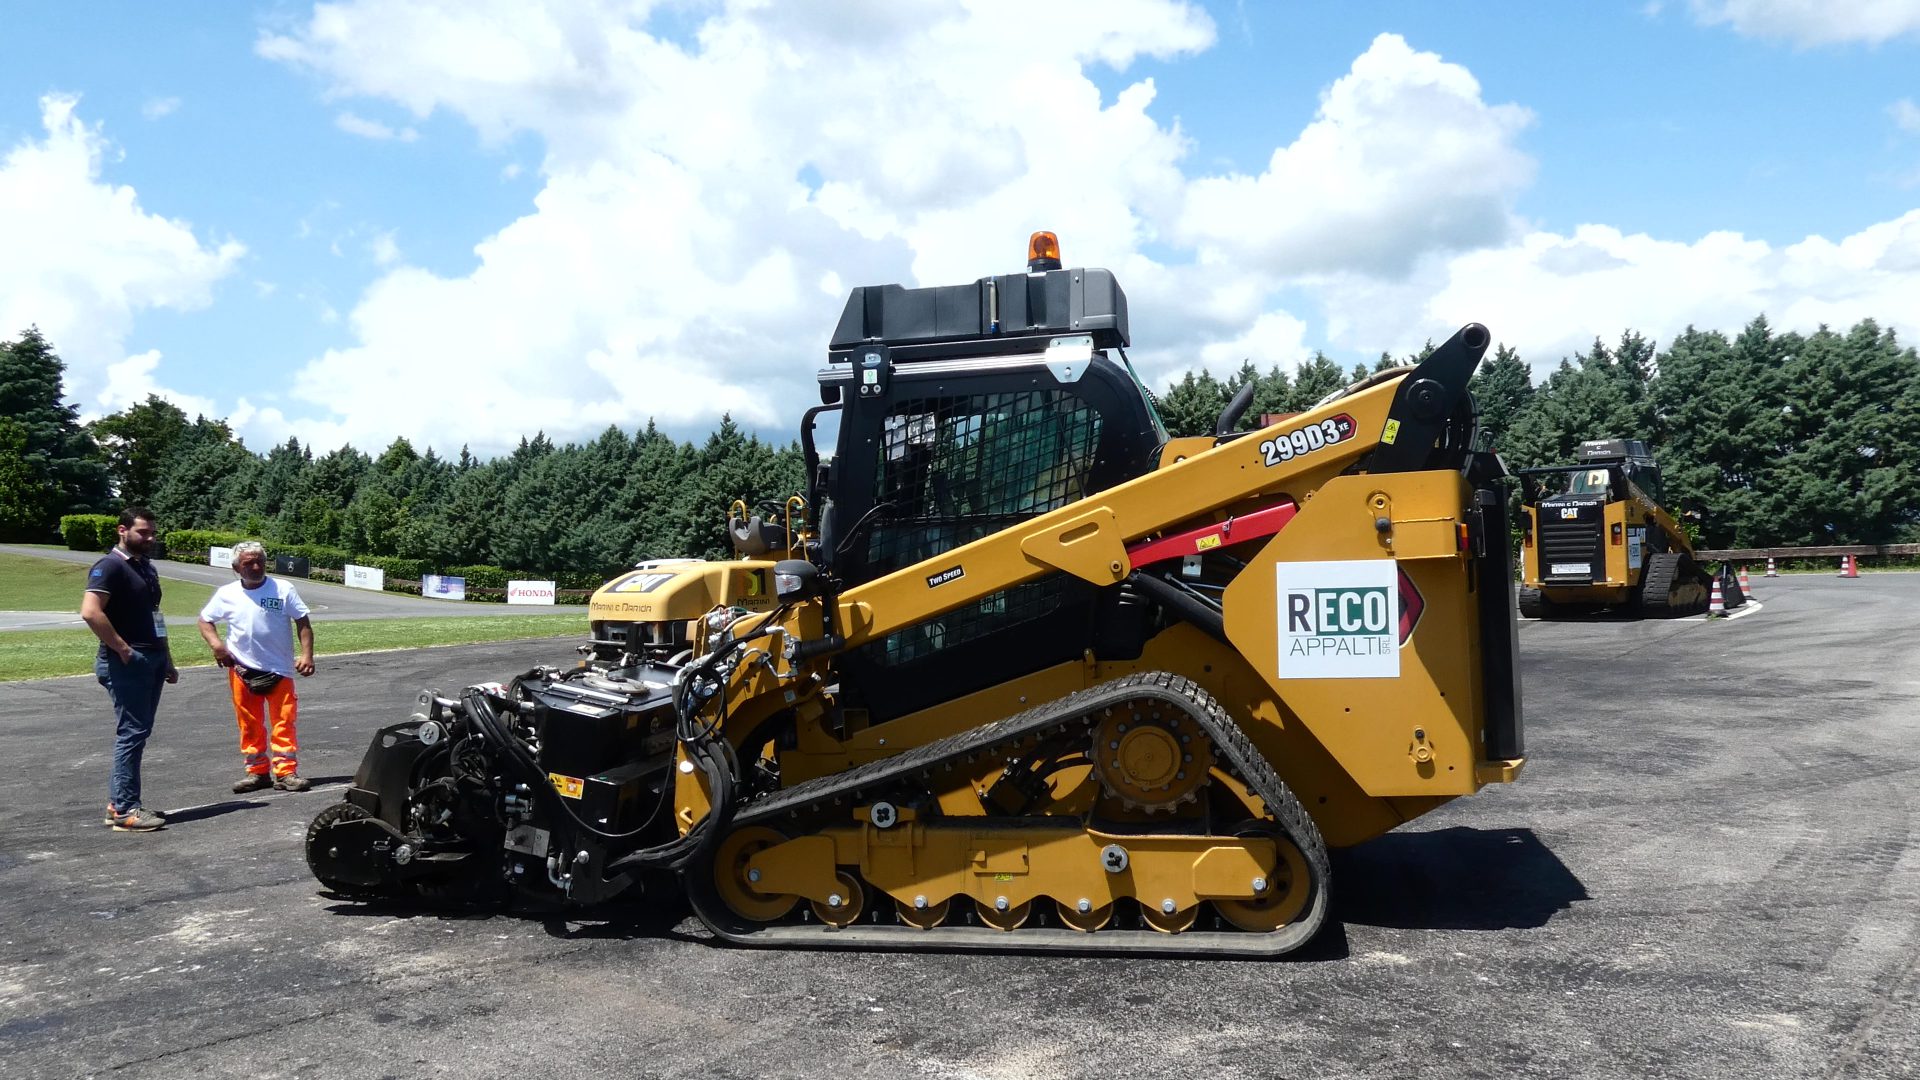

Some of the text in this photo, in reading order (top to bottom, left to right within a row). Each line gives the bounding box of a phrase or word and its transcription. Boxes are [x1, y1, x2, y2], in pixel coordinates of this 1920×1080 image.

[1260, 420, 1350, 466] 299D3 XE
[1561, 508, 1578, 519] CAT
[518, 589, 553, 597] HONDA
[1288, 591, 1387, 632] RECO
[1290, 637, 1381, 656] APPALTI
[1382, 637, 1391, 654] SRL
